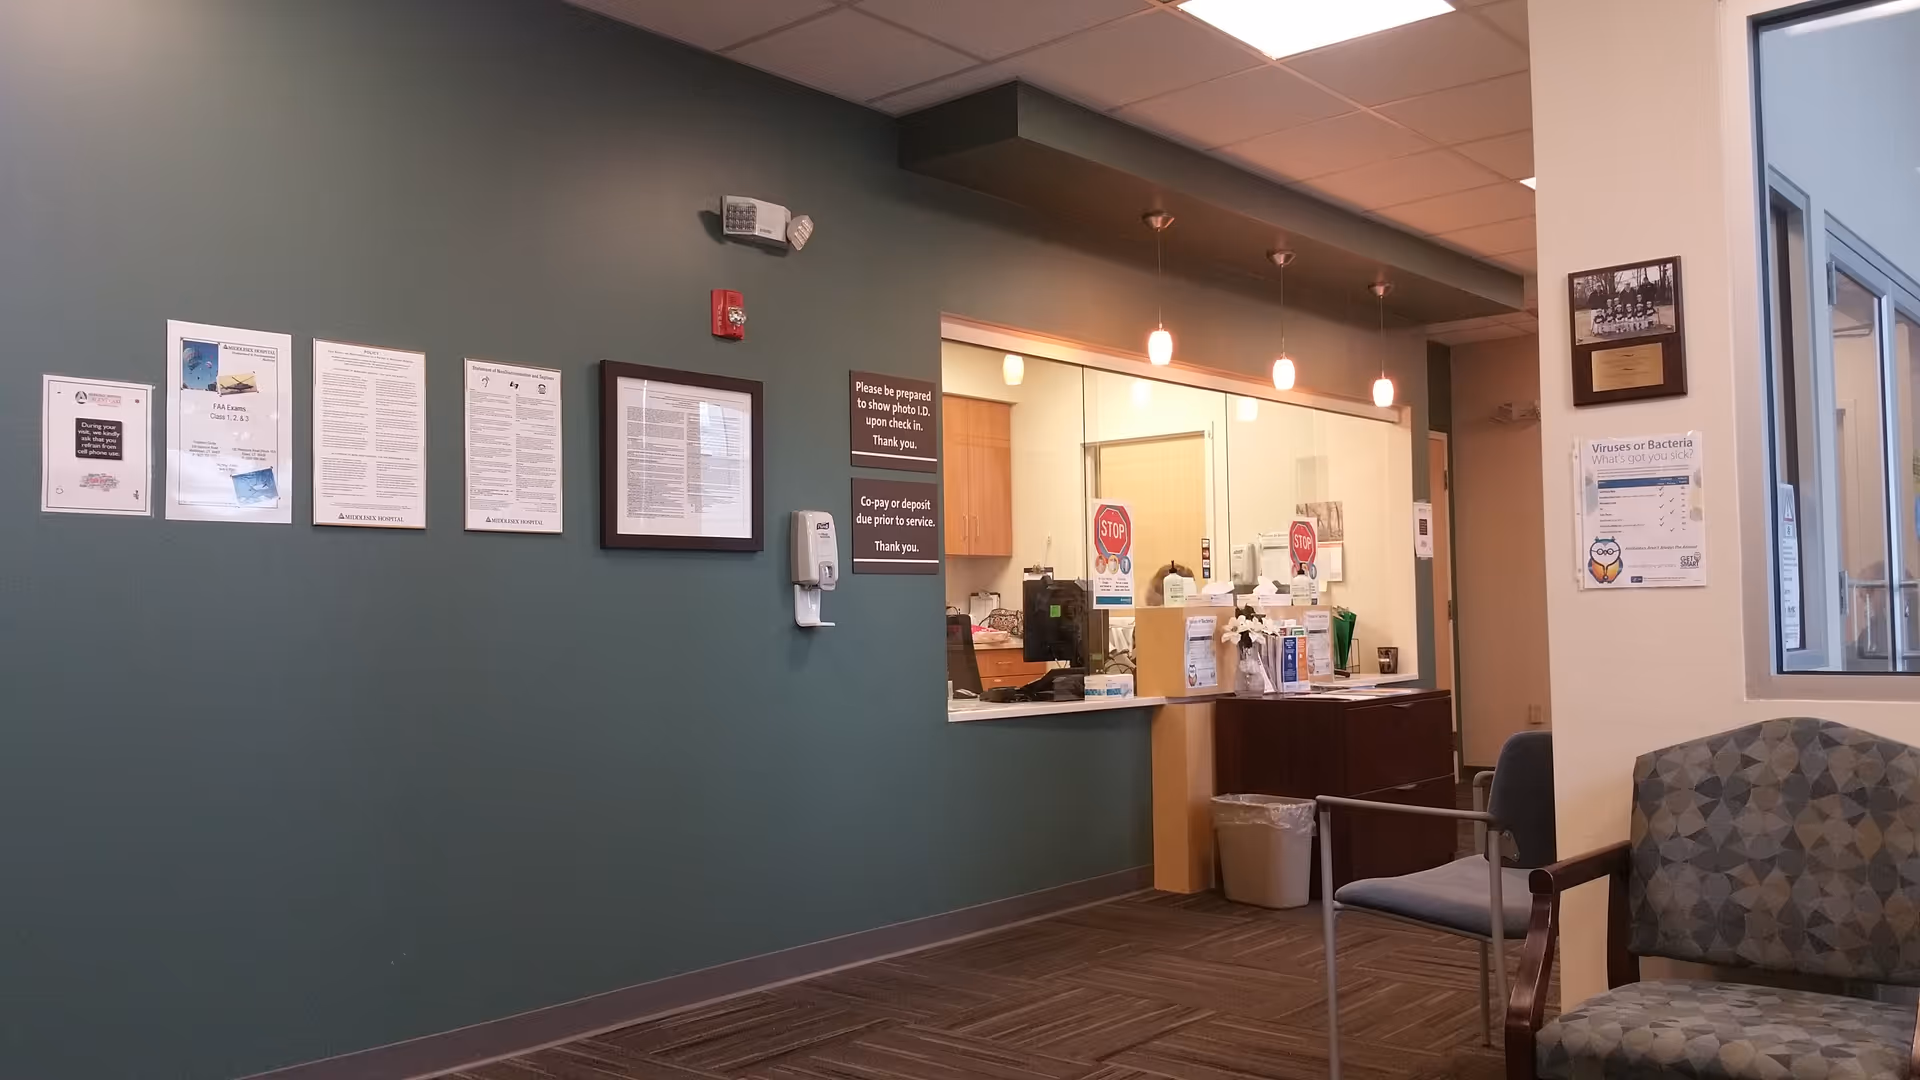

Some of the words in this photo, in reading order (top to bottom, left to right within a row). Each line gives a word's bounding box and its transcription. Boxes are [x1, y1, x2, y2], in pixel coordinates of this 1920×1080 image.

[855, 381, 882, 395] Please
[884, 384, 894, 396] be
[896, 389, 931, 402] prepared
[213, 403, 226, 411] FAA
[226, 404, 246, 412] Exams
[857, 397, 866, 408] to
[868, 398, 890, 411] show
[892, 402, 916, 415] photo
[917, 405, 930, 417] I.D.
[209, 412, 225, 420] Class
[865, 416, 887, 428] upon
[889, 417, 911, 430] check
[913, 420, 923, 431] in.
[81, 421, 102, 430] During
[873, 434, 898, 447] Thank
[899, 439, 917, 450] you.
[1592, 443, 1631, 453] Viruses
[1633, 442, 1645, 450] or
[1648, 438, 1693, 449] Bacteria
[1592, 453, 1626, 464] What's
[1628, 453, 1646, 464] got
[1648, 452, 1667, 464] you
[1670, 448, 1694, 460] sick?
[860, 496, 889, 510] Co-pay
[891, 500, 900, 508] or
[901, 498, 930, 512] deposit
[856, 513, 872, 524] due
[874, 514, 894, 527] prior
[896, 515, 904, 525] to
[906, 516, 936, 527] service.
[1101, 519, 1124, 539] STOP
[874, 540, 900, 551] Thank
[901, 543, 919, 554] you.
[1294, 533, 1312, 550] STOP
